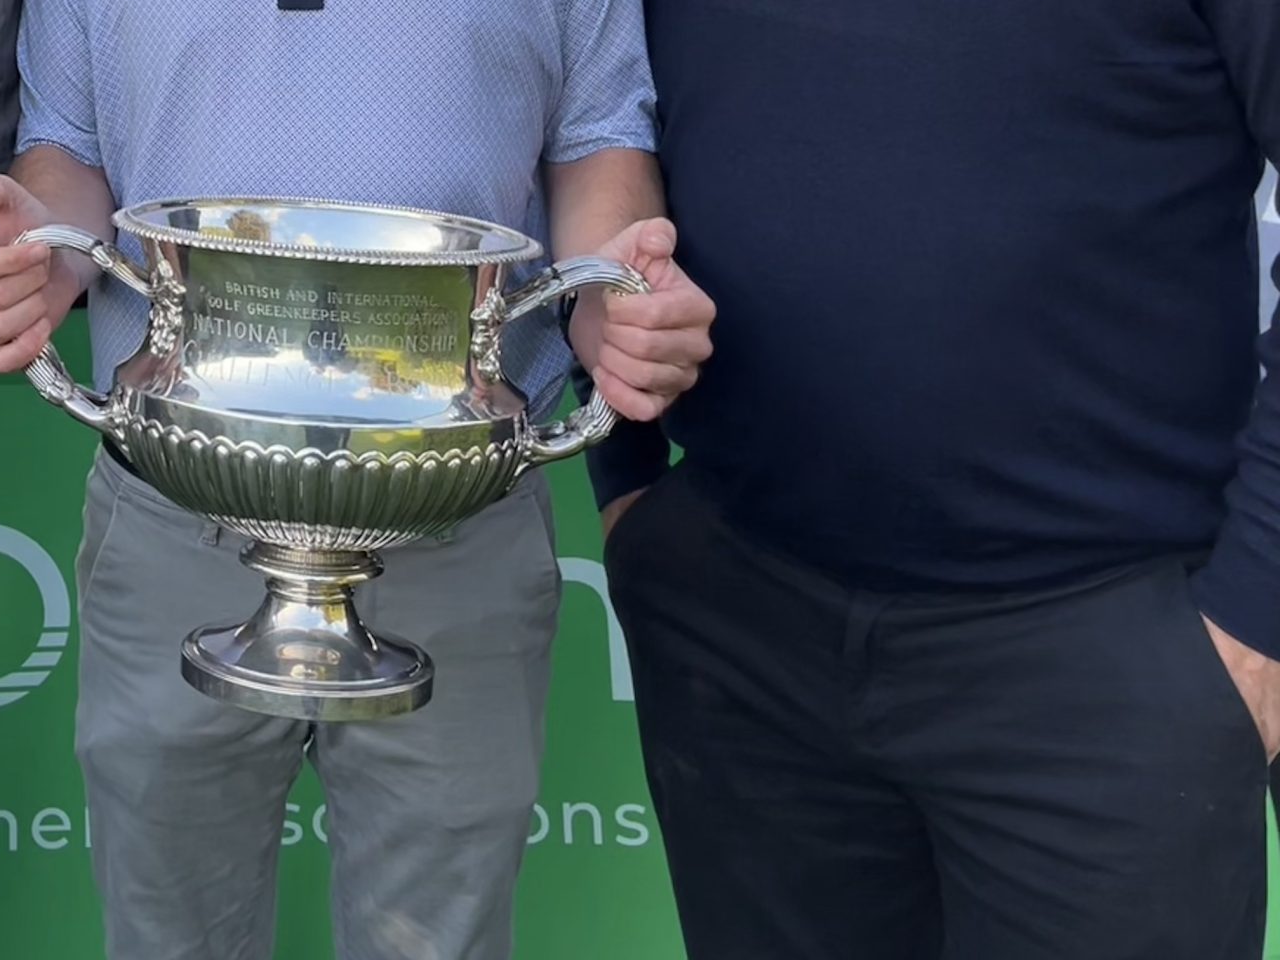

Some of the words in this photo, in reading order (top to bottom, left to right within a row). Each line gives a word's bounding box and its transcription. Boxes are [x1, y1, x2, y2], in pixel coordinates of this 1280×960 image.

[225, 281, 280, 300] BRITISH
[286, 289, 318, 304] AND
[327, 291, 439, 307] INTERNATIONAL
[208, 296, 241, 312] GOLF
[247, 302, 361, 324] GREENKEEPERS
[368, 312, 449, 326] ASSOCIATION
[193, 312, 294, 347] NATIONAL
[307, 330, 458, 353] CHAMPIONSHIP
